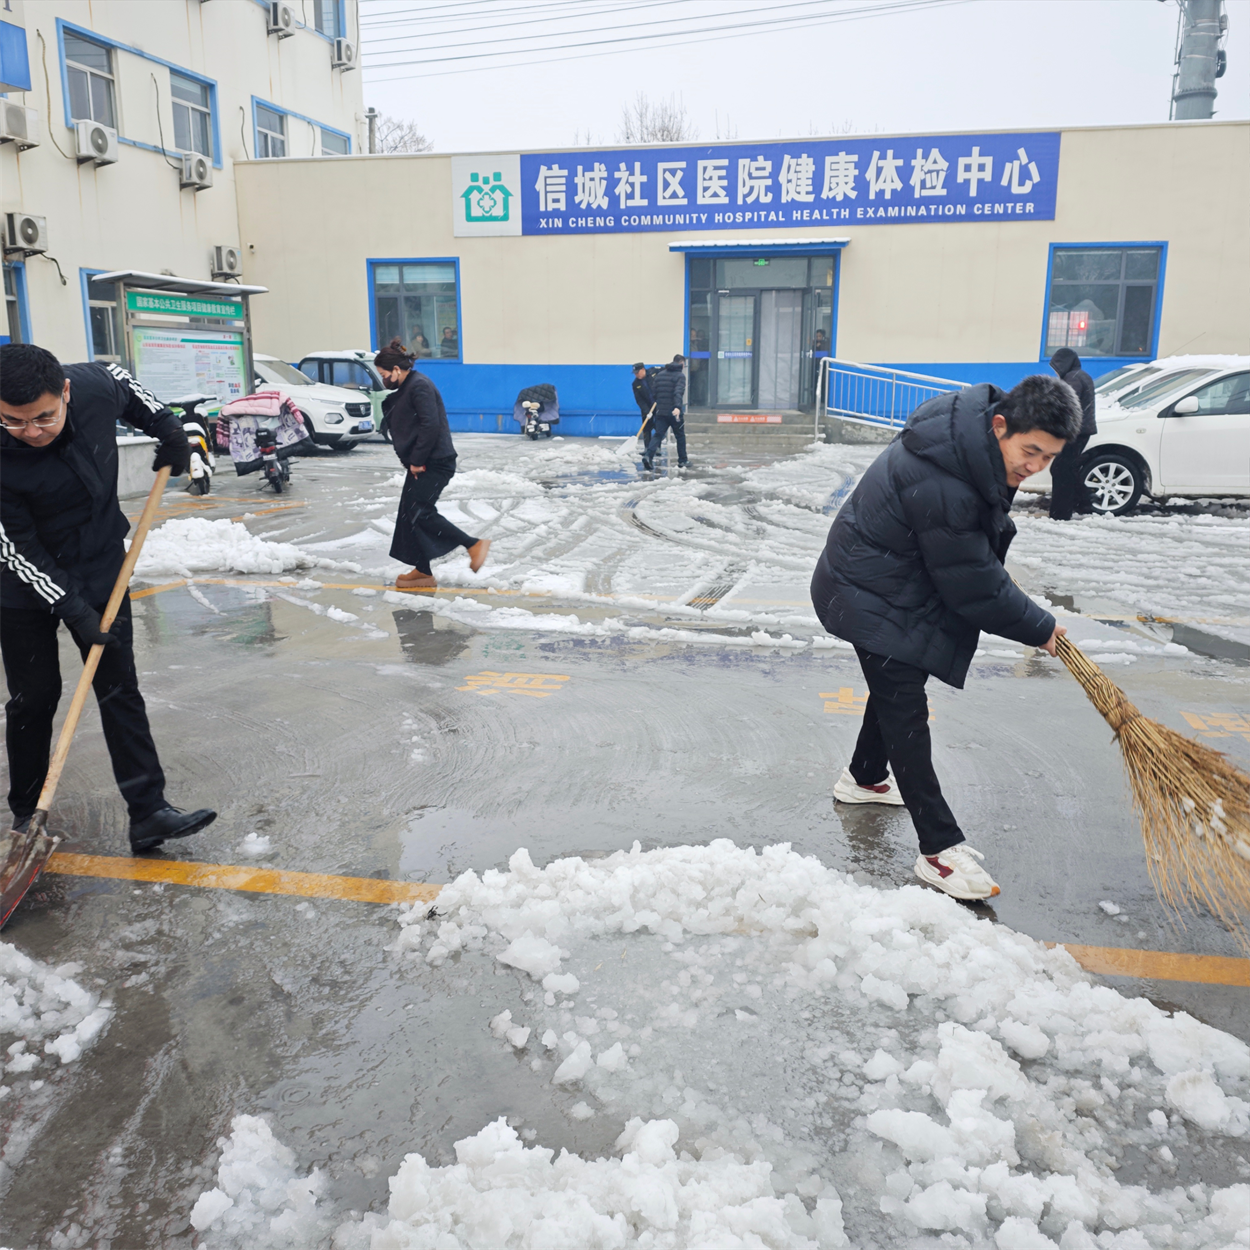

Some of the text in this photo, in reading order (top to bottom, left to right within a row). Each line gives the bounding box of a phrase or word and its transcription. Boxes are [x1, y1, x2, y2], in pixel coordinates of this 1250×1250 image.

[535, 146, 1040, 212] 信城社区医院健康体检中心
[539, 202, 1035, 228] XIN CHENG COMMUNITY HOSPITAL HEALTH EXAMINATION CENTER
